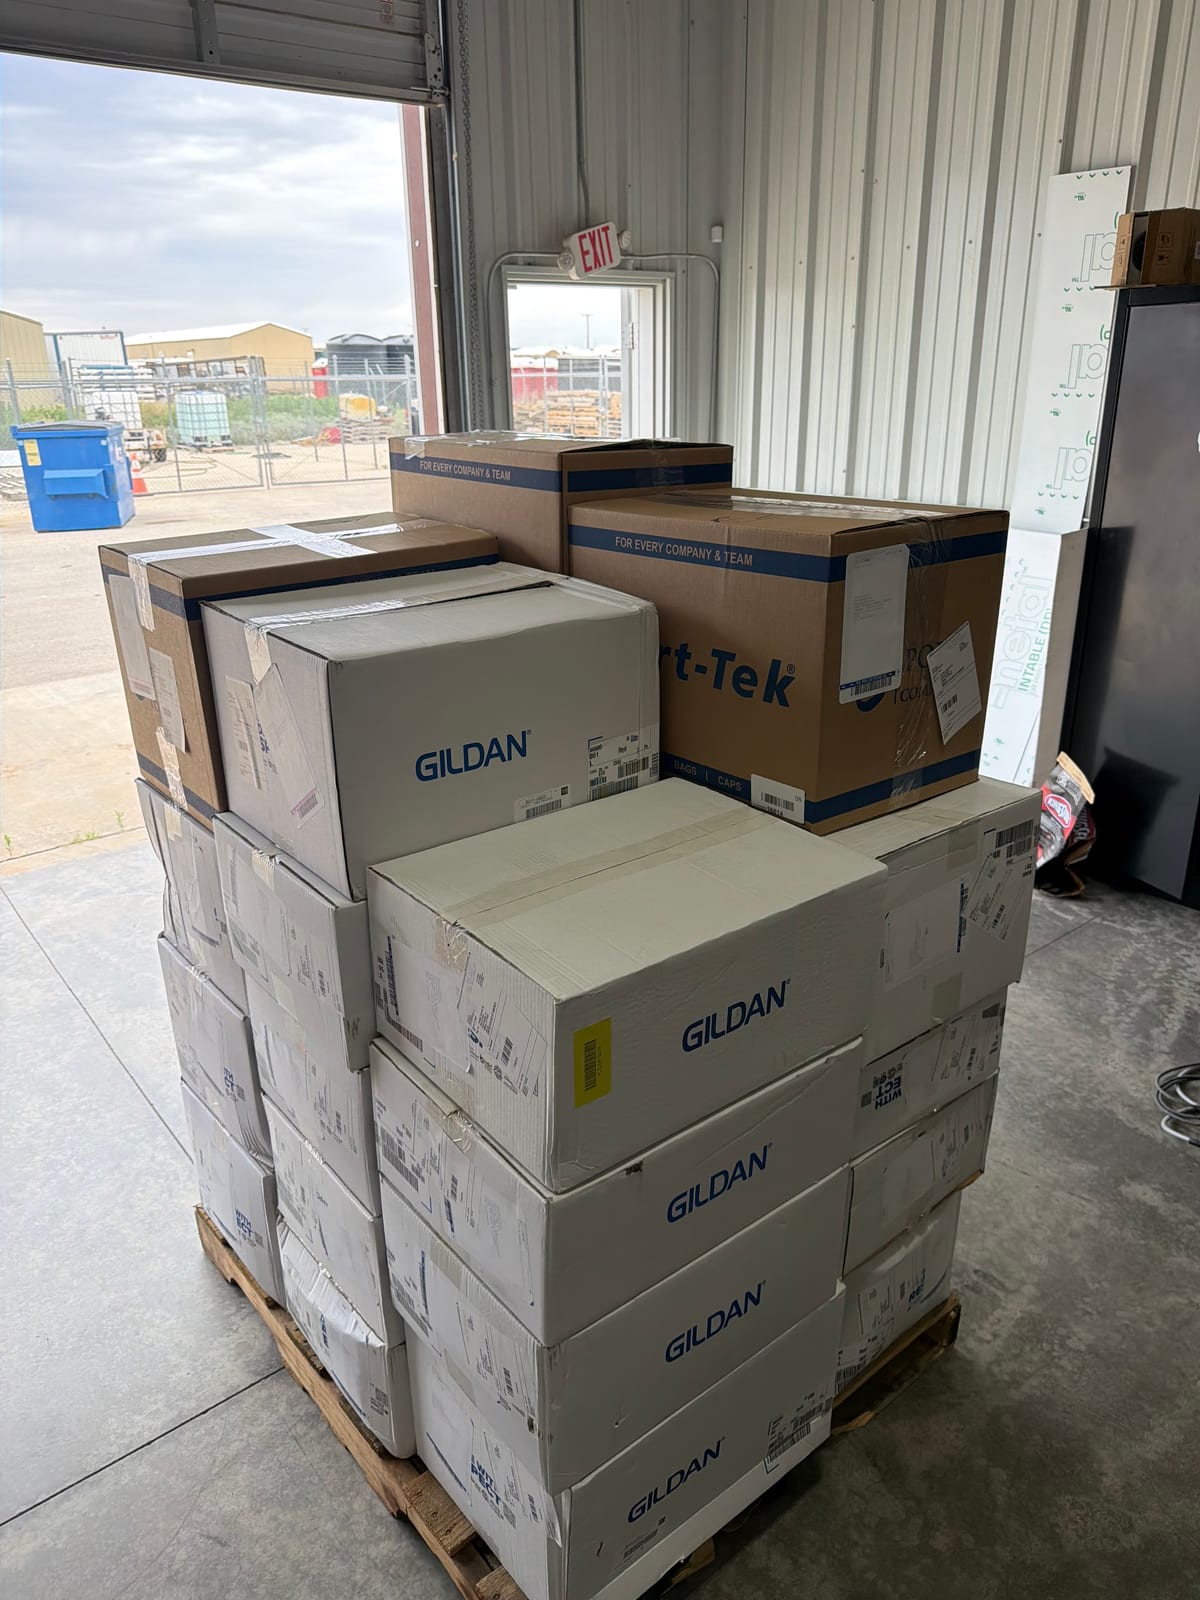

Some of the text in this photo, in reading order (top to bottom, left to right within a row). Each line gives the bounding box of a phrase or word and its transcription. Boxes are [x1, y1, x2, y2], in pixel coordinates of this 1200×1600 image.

[578, 225, 614, 273] EXIT
[419, 460, 511, 482] FOR EVERY COMPANY & TEAM
[615, 536, 753, 567] FOR EVERY COMPANY & TEAM
[660, 643, 796, 708] rt-Tek
[1017, 636, 1046, 693] INTABLE
[415, 730, 528, 782] GILDAN
[674, 760, 742, 791] BAGS CAPS
[682, 980, 787, 1053] GILDAN
[667, 1145, 768, 1224] GILDAN
[665, 1282, 764, 1364] GILDAN
[627, 1440, 723, 1524] GILDAN
